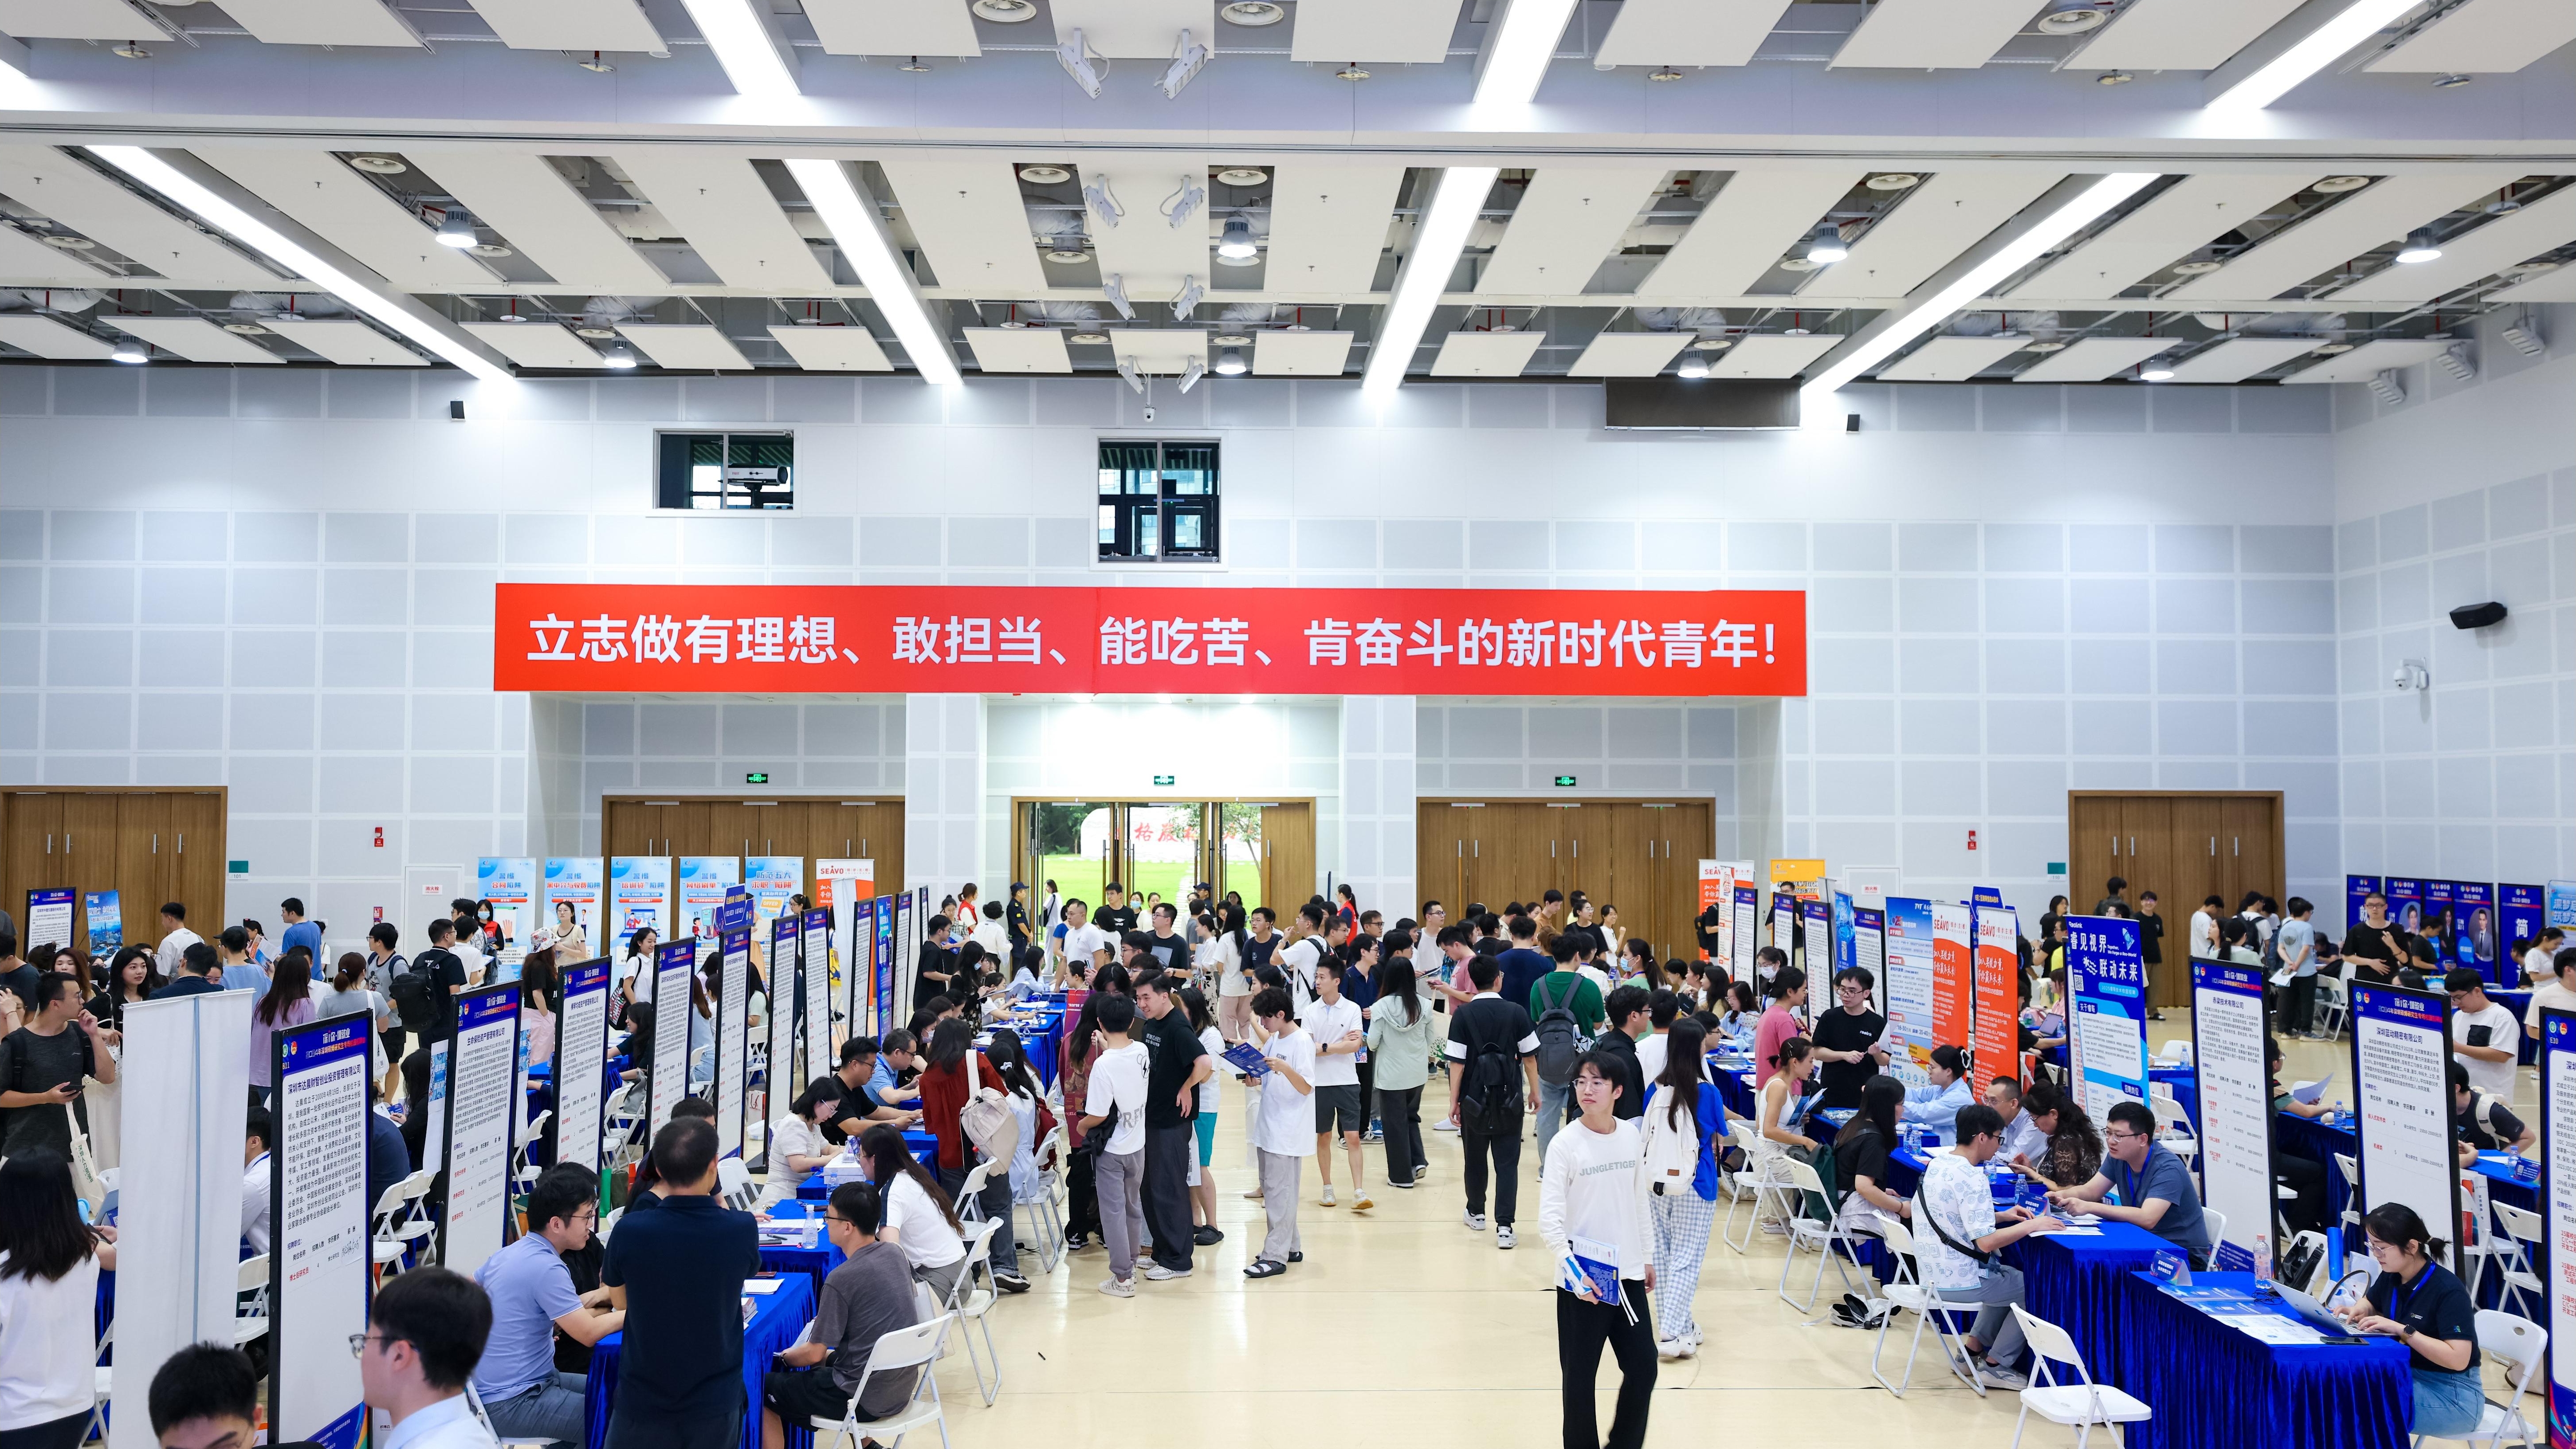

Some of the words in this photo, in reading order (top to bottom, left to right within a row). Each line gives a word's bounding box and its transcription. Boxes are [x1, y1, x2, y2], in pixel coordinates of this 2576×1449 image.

[821, 865, 844, 874] SEAVO
[1934, 915, 1949, 931] SEAVO
[1980, 920, 1995, 937] SEAVO
[2516, 919, 2528, 938] 简
[2070, 931, 2106, 953] 睿见视界
[2099, 959, 2137, 982] 联动未来
[2102, 985, 2136, 995] 2025睿联技术校园招聘
[2080, 1003, 2095, 1013] 关于睿联
[2213, 997, 2244, 1009] 赤梁技术有限公司
[467, 1027, 505, 1046] 生命保险资产管理有限公司
[2376, 1027, 2423, 1044] 深圳蓝动精密有限公司
[288, 1064, 361, 1095] 深圳市达晨财智创业投资管理有限公司
[2124, 1084, 2139, 1096] 招聘岗位
[2368, 1113, 2386, 1123] 嵌入式软件类
